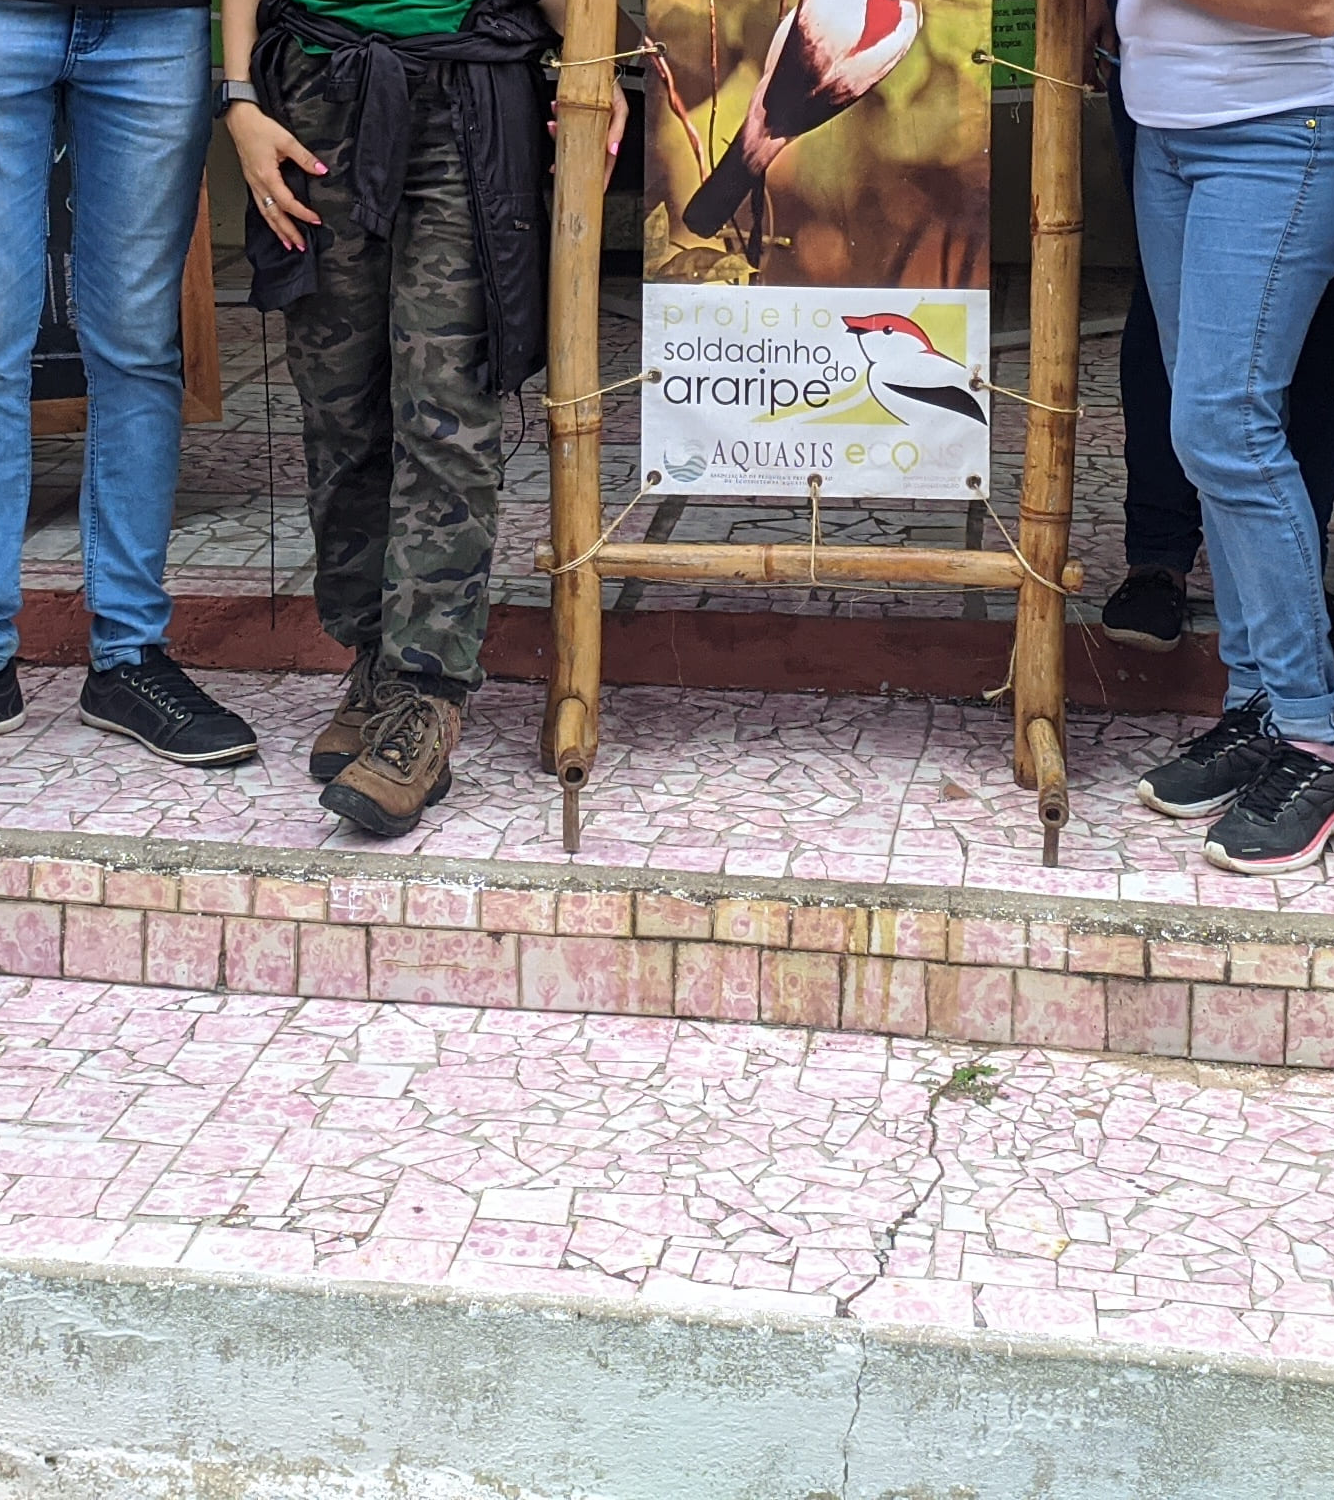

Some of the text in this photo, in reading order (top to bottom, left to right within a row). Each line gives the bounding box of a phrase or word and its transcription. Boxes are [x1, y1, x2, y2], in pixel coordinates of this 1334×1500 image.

[663, 300, 832, 334] projeto
[664, 336, 857, 383] soldadinho do
[663, 367, 831, 416] araripe
[711, 439, 834, 473] AQUASIS
